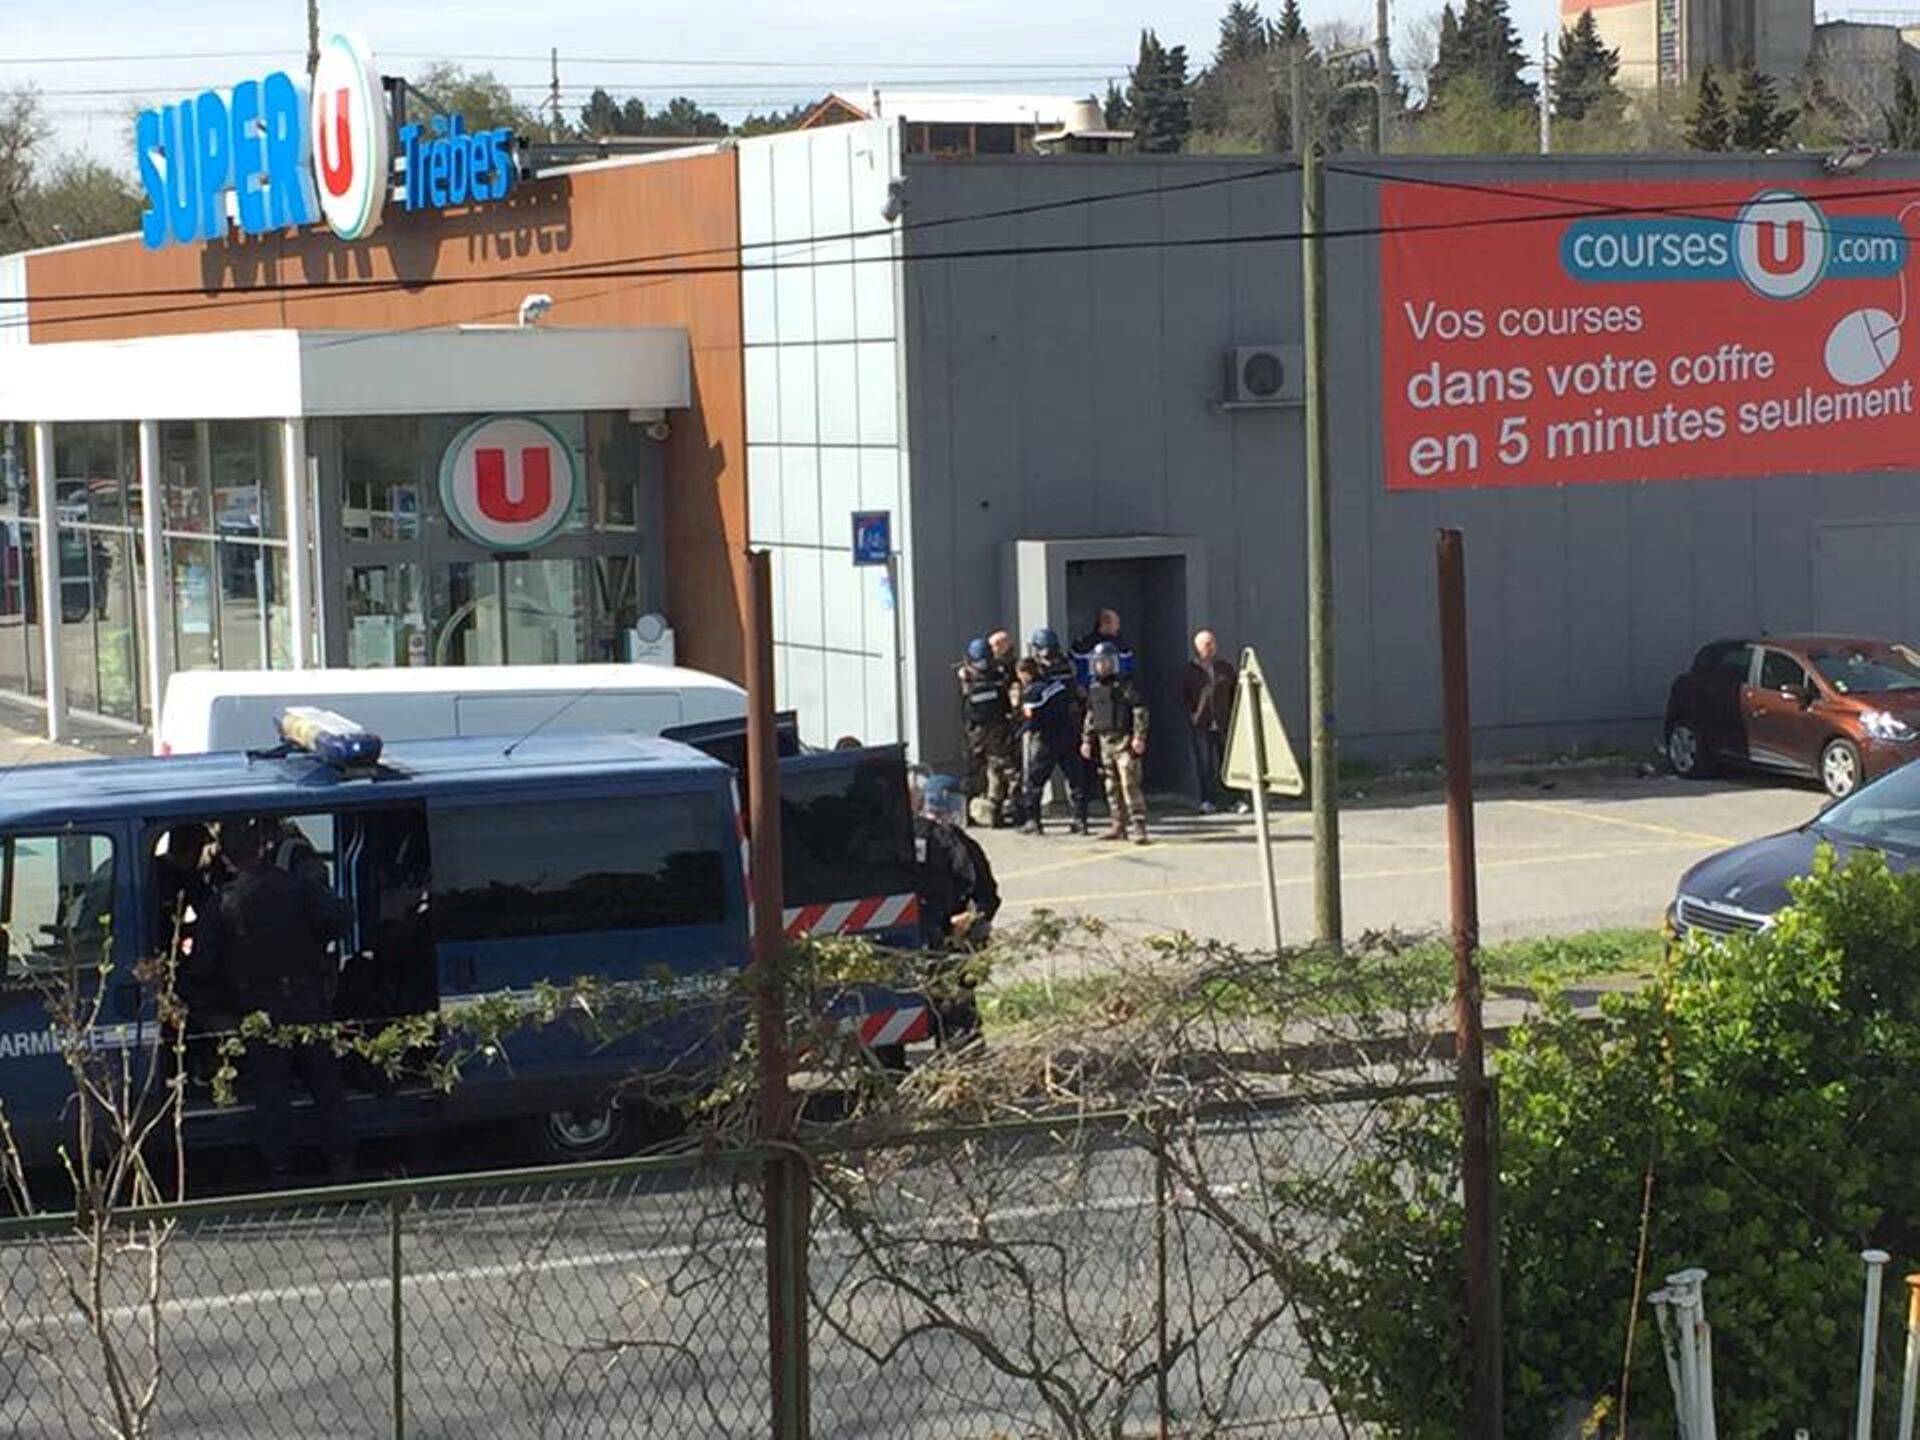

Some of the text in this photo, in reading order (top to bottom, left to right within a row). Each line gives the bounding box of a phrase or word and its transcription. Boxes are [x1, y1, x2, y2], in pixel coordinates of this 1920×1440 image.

[137, 71, 516, 250] SUPER U Trèbes
[1573, 230, 1727, 268] courses
[1756, 220, 1805, 275] U
[1404, 302, 1643, 340] Vos courses
[1406, 345, 1775, 409] dans votre coffre
[1408, 381, 1913, 477] en 5 minutes seulement
[474, 447, 552, 523] U
